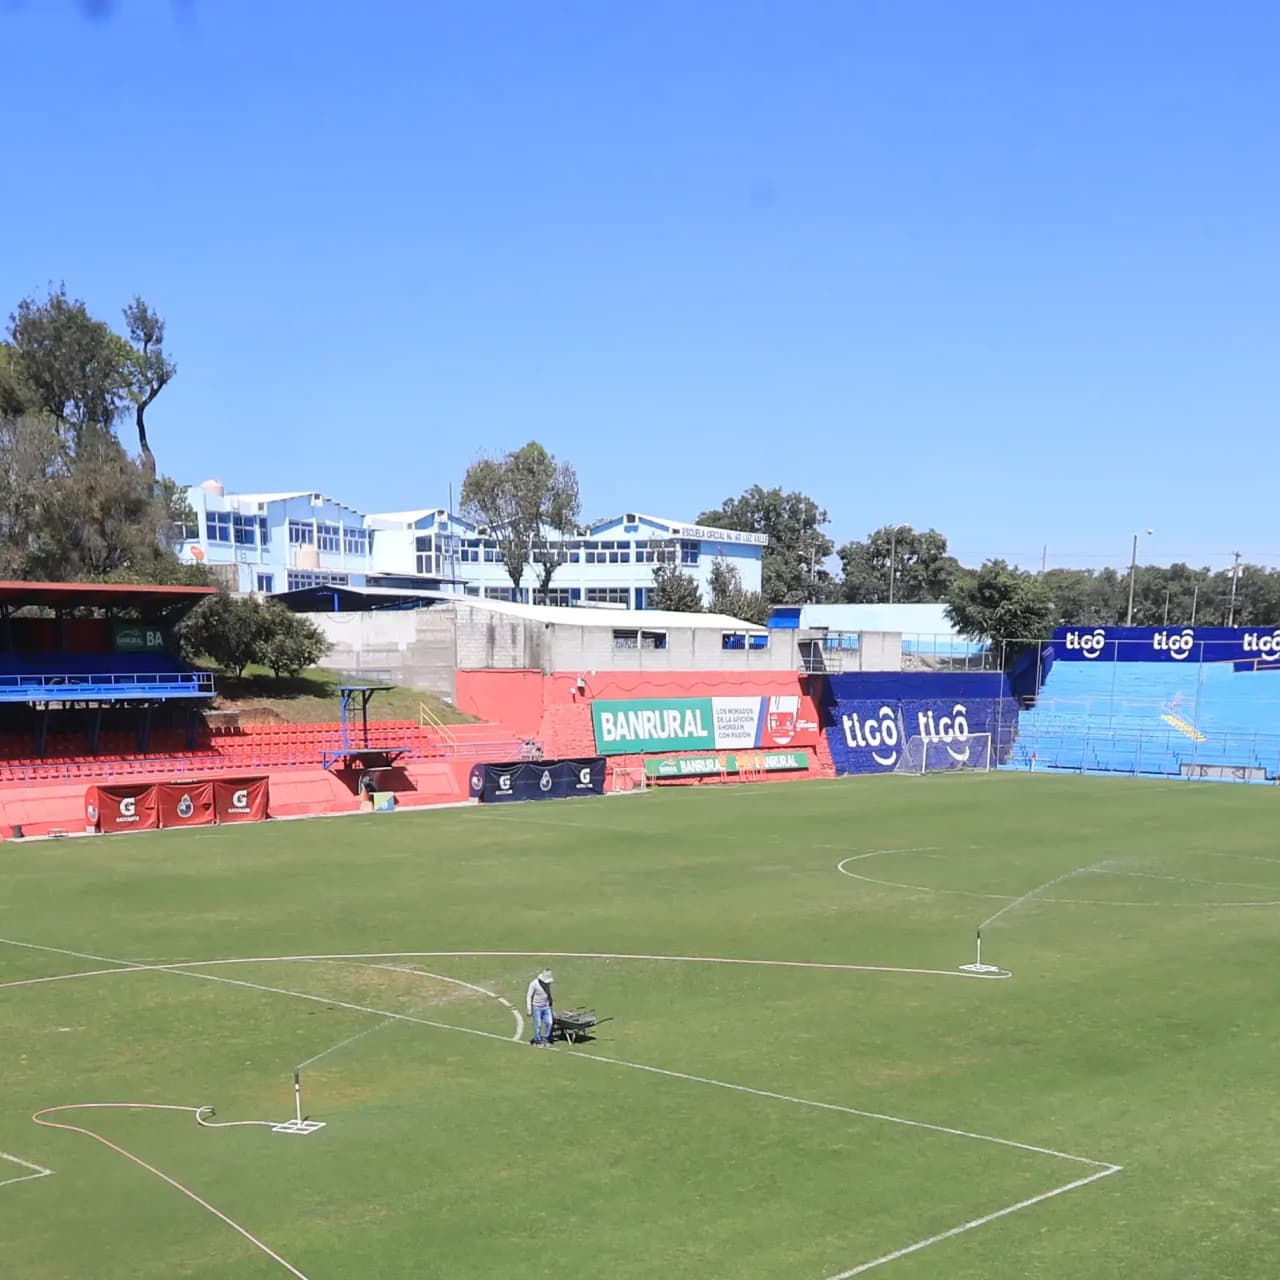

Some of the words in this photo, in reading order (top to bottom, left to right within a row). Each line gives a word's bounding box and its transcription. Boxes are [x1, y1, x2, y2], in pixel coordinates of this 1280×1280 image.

[682, 527, 705, 538] ESCUELA
[706, 530, 725, 540] OFICIAL
[600, 709, 709, 742] BANRURAL
